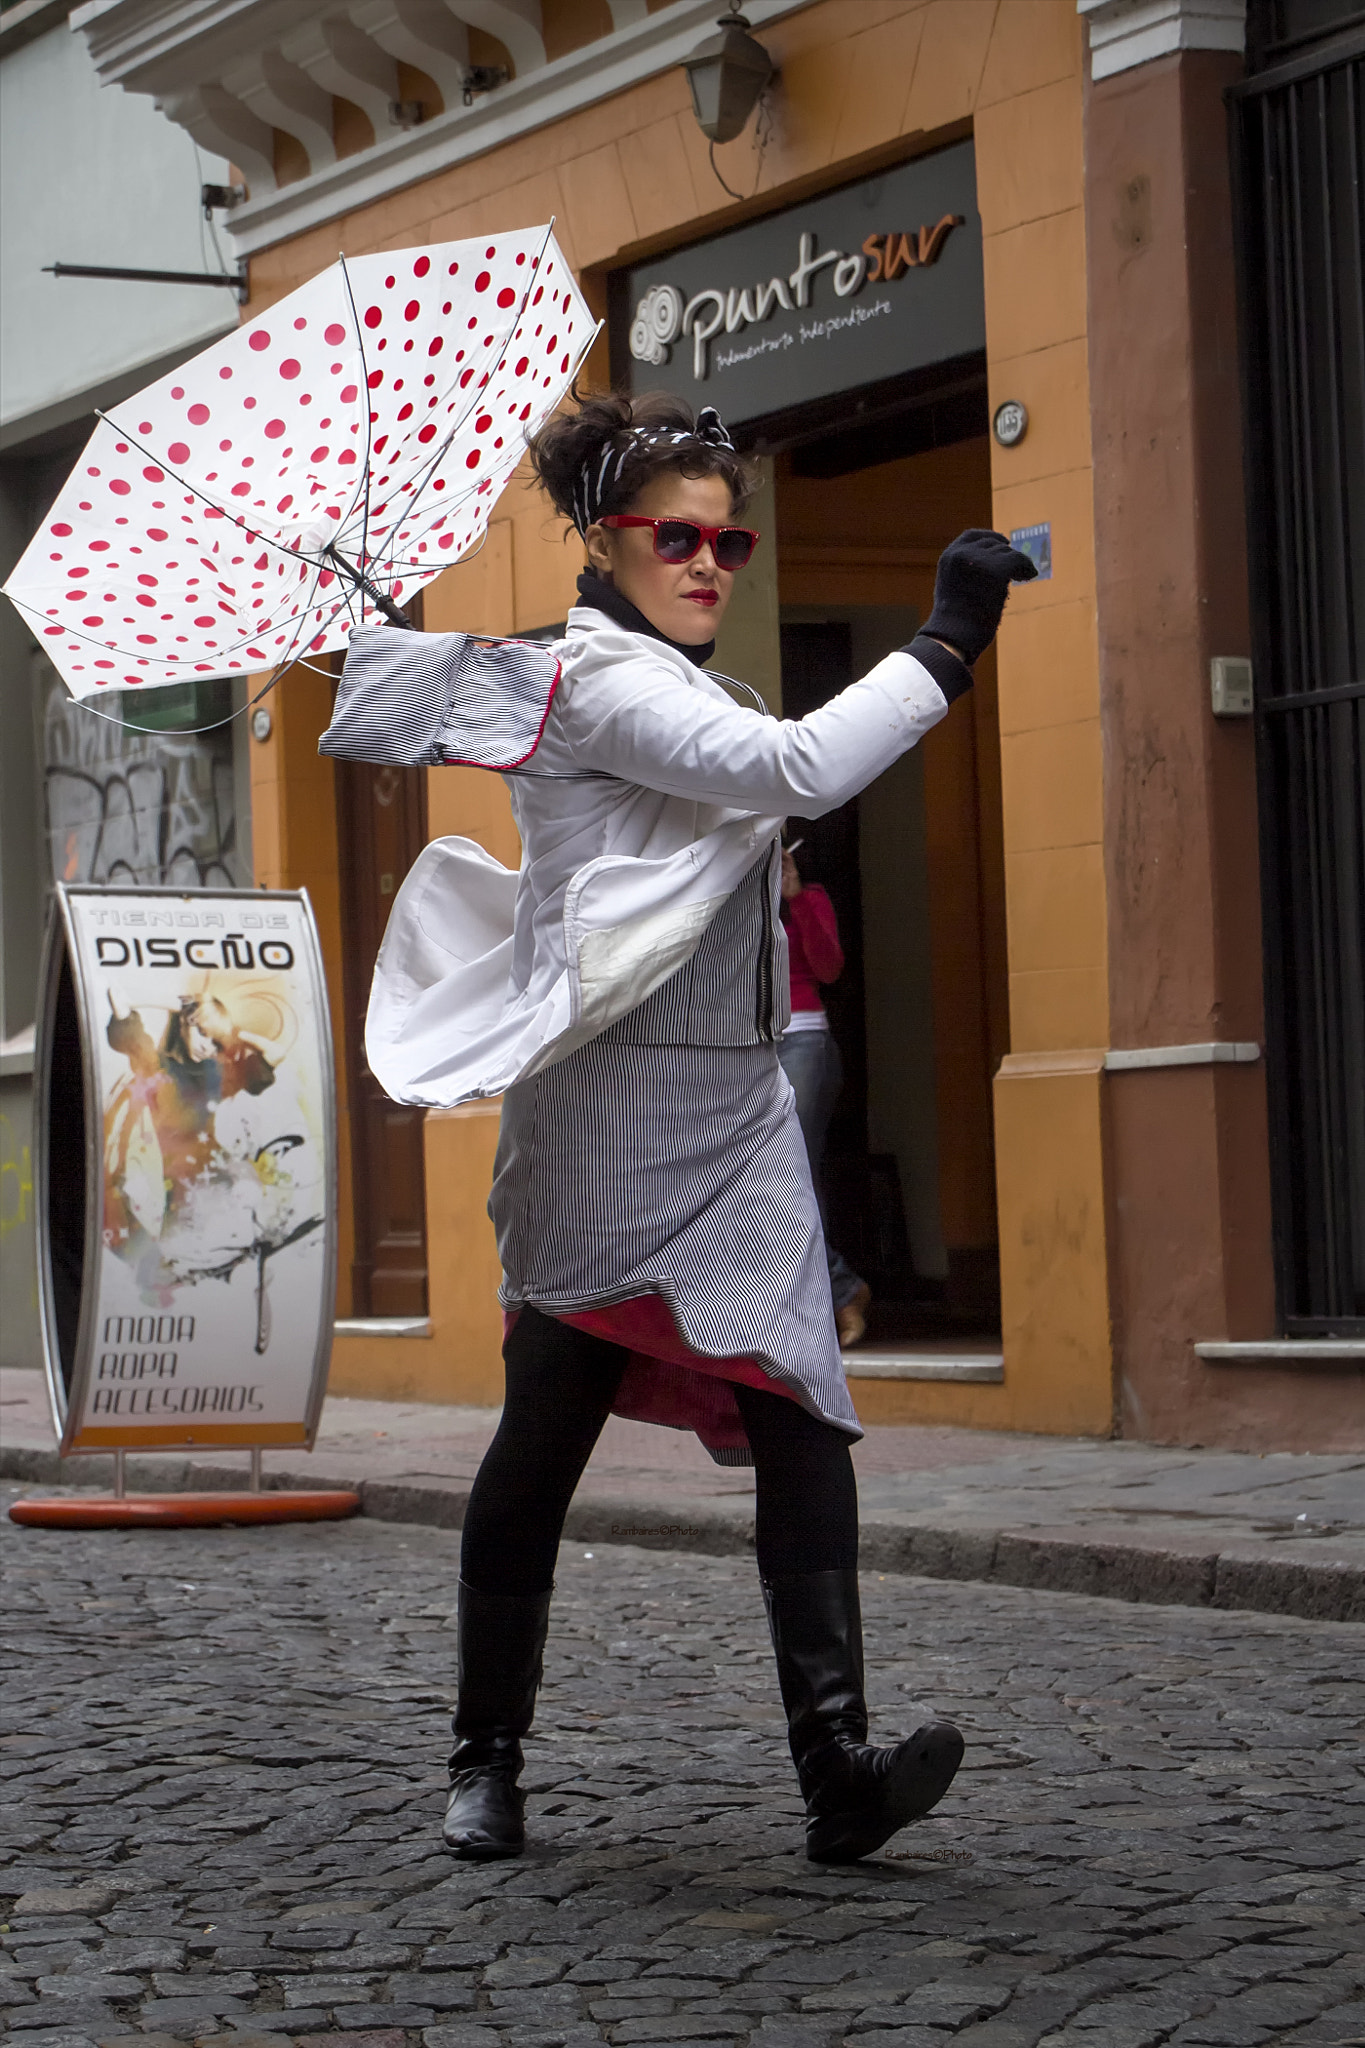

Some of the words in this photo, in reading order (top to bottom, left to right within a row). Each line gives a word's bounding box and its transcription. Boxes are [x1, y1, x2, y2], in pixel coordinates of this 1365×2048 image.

[799, 300, 892, 345] independiente
[89, 909, 225, 928] TIENDA
[239, 912, 290, 929] DE
[103, 1315, 196, 1344] MODA
[98, 1352, 178, 1380] ROPA
[92, 1385, 265, 1414] ACCESORIOS
